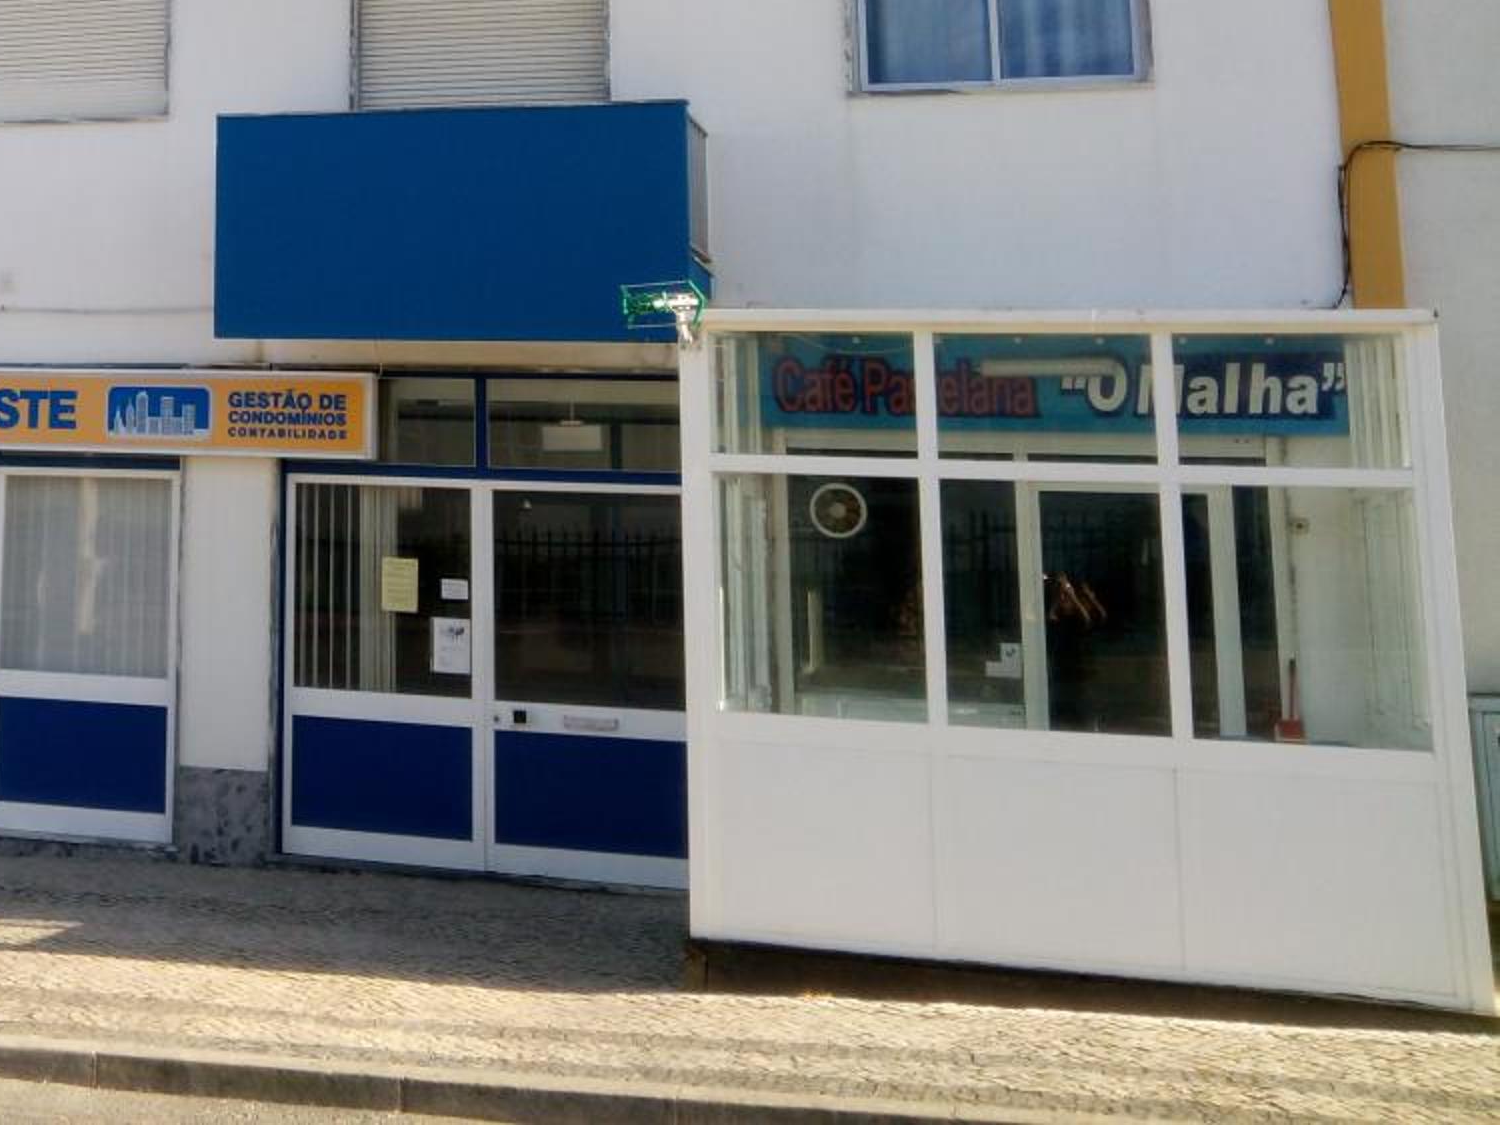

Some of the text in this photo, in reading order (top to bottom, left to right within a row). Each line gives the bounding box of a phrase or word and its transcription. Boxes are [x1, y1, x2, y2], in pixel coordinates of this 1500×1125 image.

[775, 355, 1037, 416] Café Paelaria
[228, 389, 347, 410] GESTÃO DE
[228, 409, 347, 425] CONDOMÍNIOS
[227, 426, 347, 440] CONTABILIDADE
